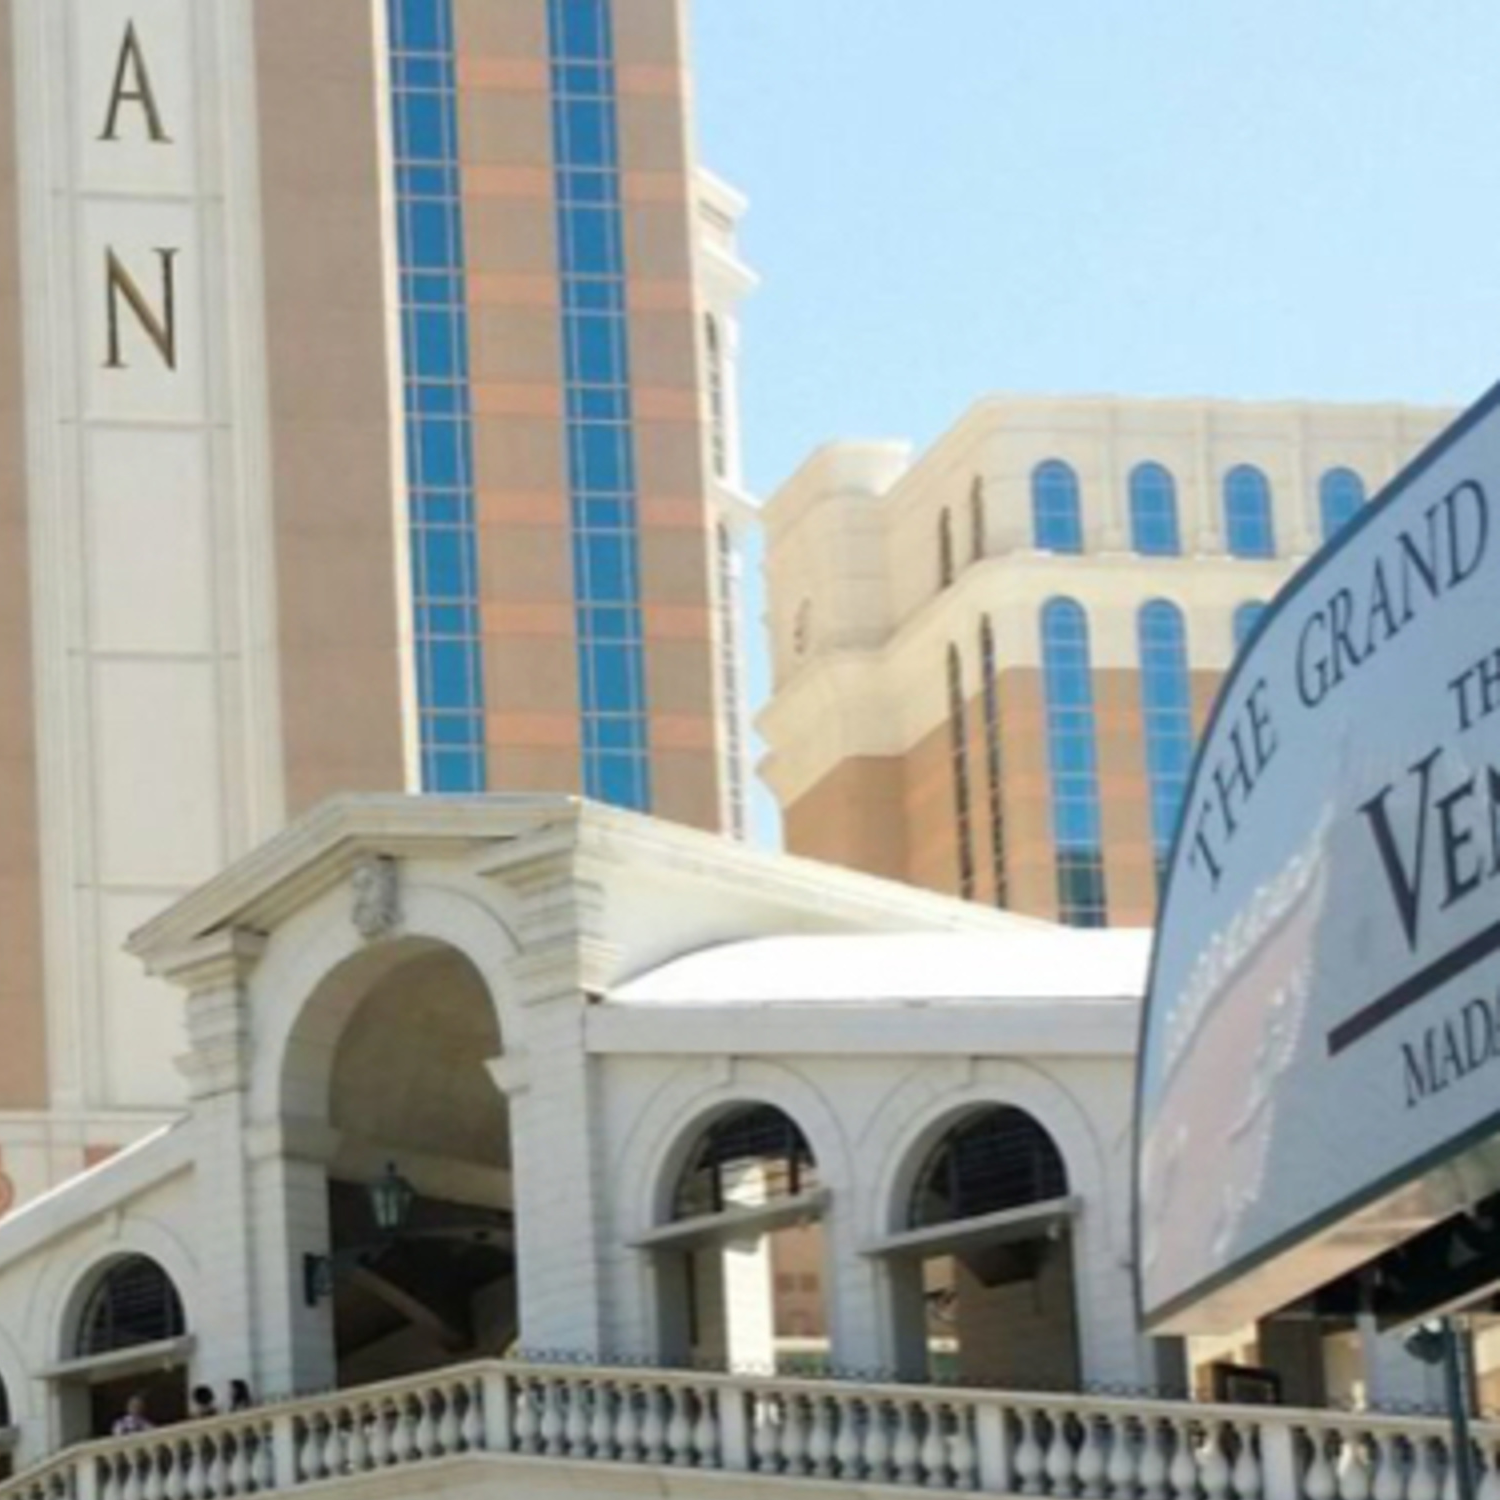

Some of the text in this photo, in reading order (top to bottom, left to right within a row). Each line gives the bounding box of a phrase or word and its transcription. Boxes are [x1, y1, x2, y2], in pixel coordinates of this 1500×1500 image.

[1188, 477, 1489, 893] THE GRAND
[1401, 982, 1500, 1109] MAD
